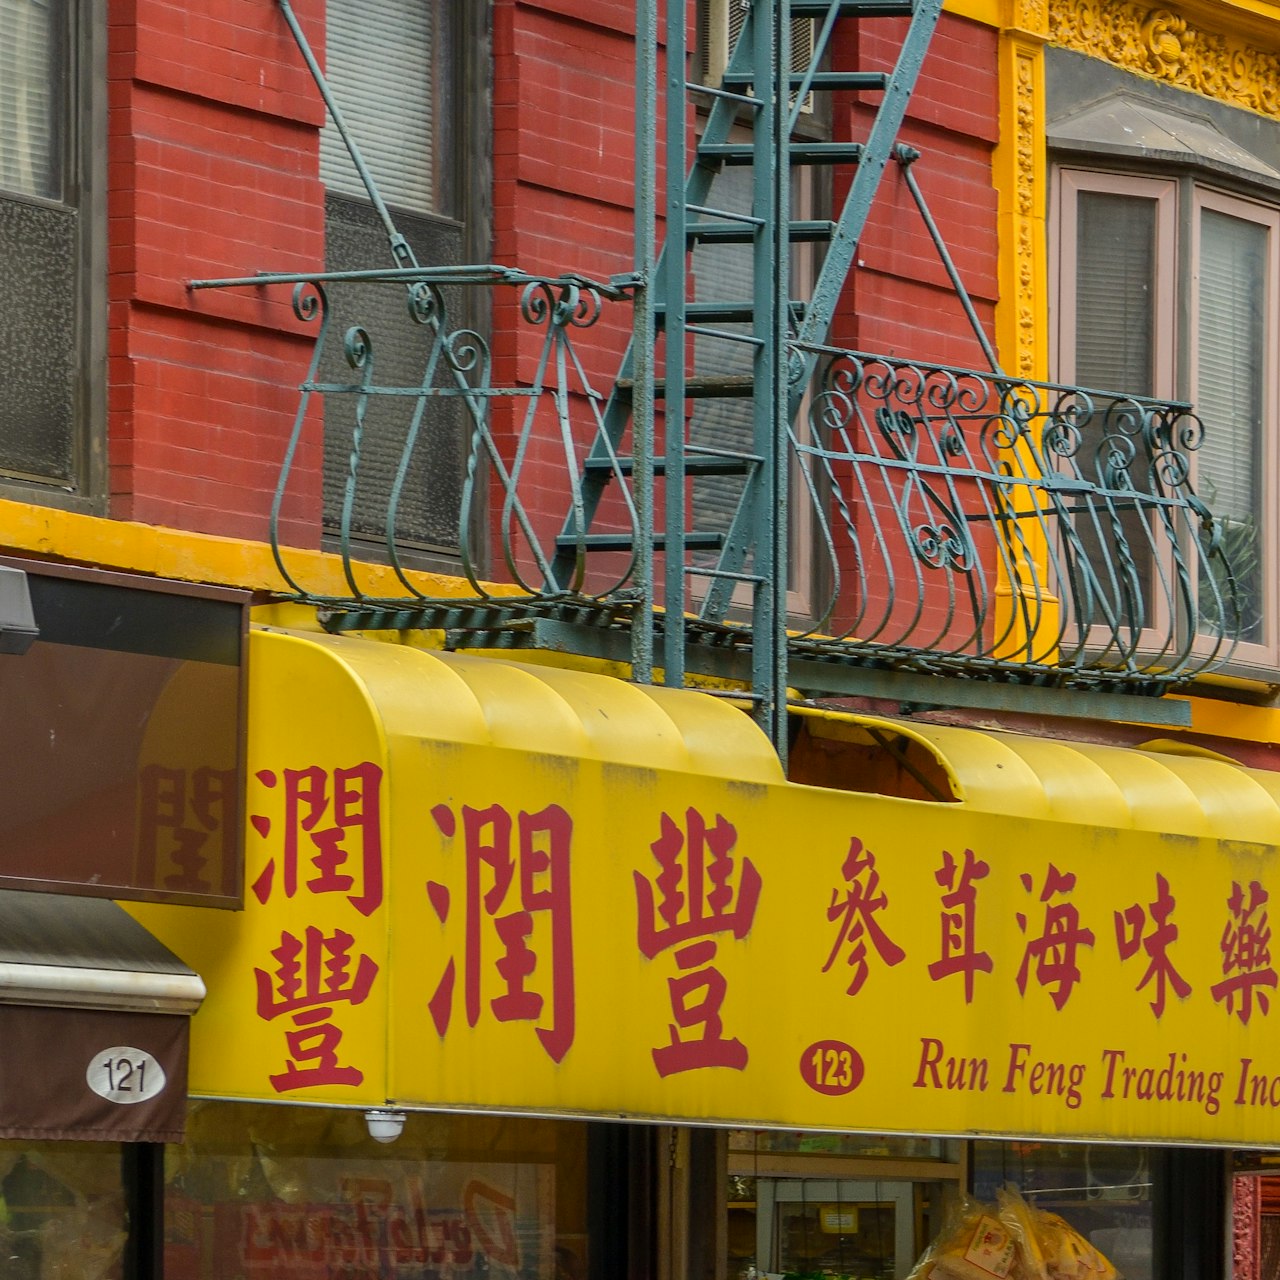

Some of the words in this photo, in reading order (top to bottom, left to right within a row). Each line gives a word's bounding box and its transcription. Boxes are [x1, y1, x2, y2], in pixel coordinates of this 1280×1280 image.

[251, 761, 384, 1093] 潤豐
[427, 803, 763, 1079] 潤豐
[103, 1058, 146, 1094] 121
[812, 1048, 853, 1088] 123
[914, 1038, 988, 1091] Run
[1003, 1044, 1086, 1109] Feng
[1101, 1050, 1224, 1115] Trading
